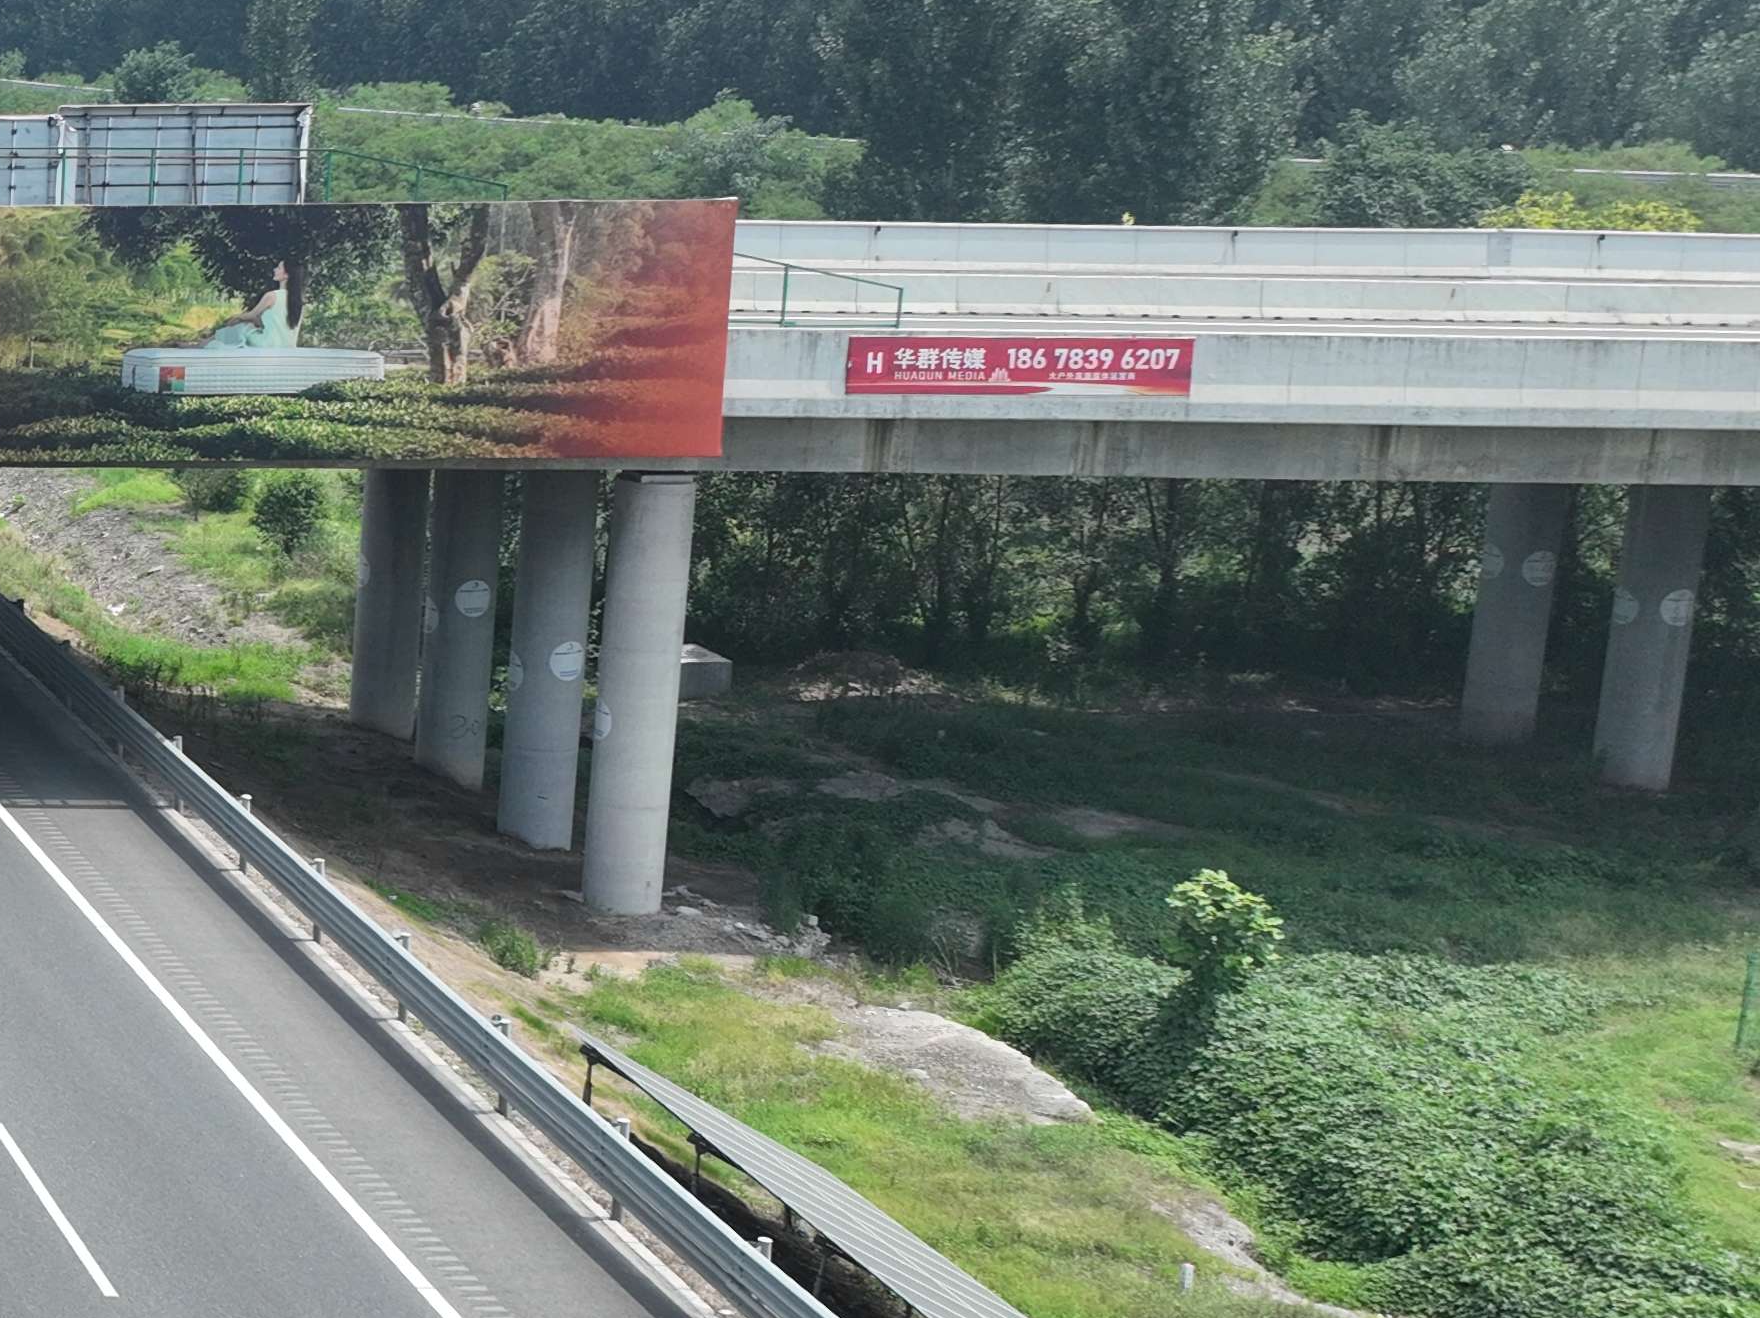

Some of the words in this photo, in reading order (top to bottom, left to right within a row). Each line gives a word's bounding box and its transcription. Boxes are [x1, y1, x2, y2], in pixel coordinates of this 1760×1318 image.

[894, 348, 986, 369] 华群传媒
[1006, 348, 1046, 369] 186
[1055, 349, 1113, 369] 7839
[1121, 349, 1180, 369] 6207
[948, 371, 986, 381] MEDIA
